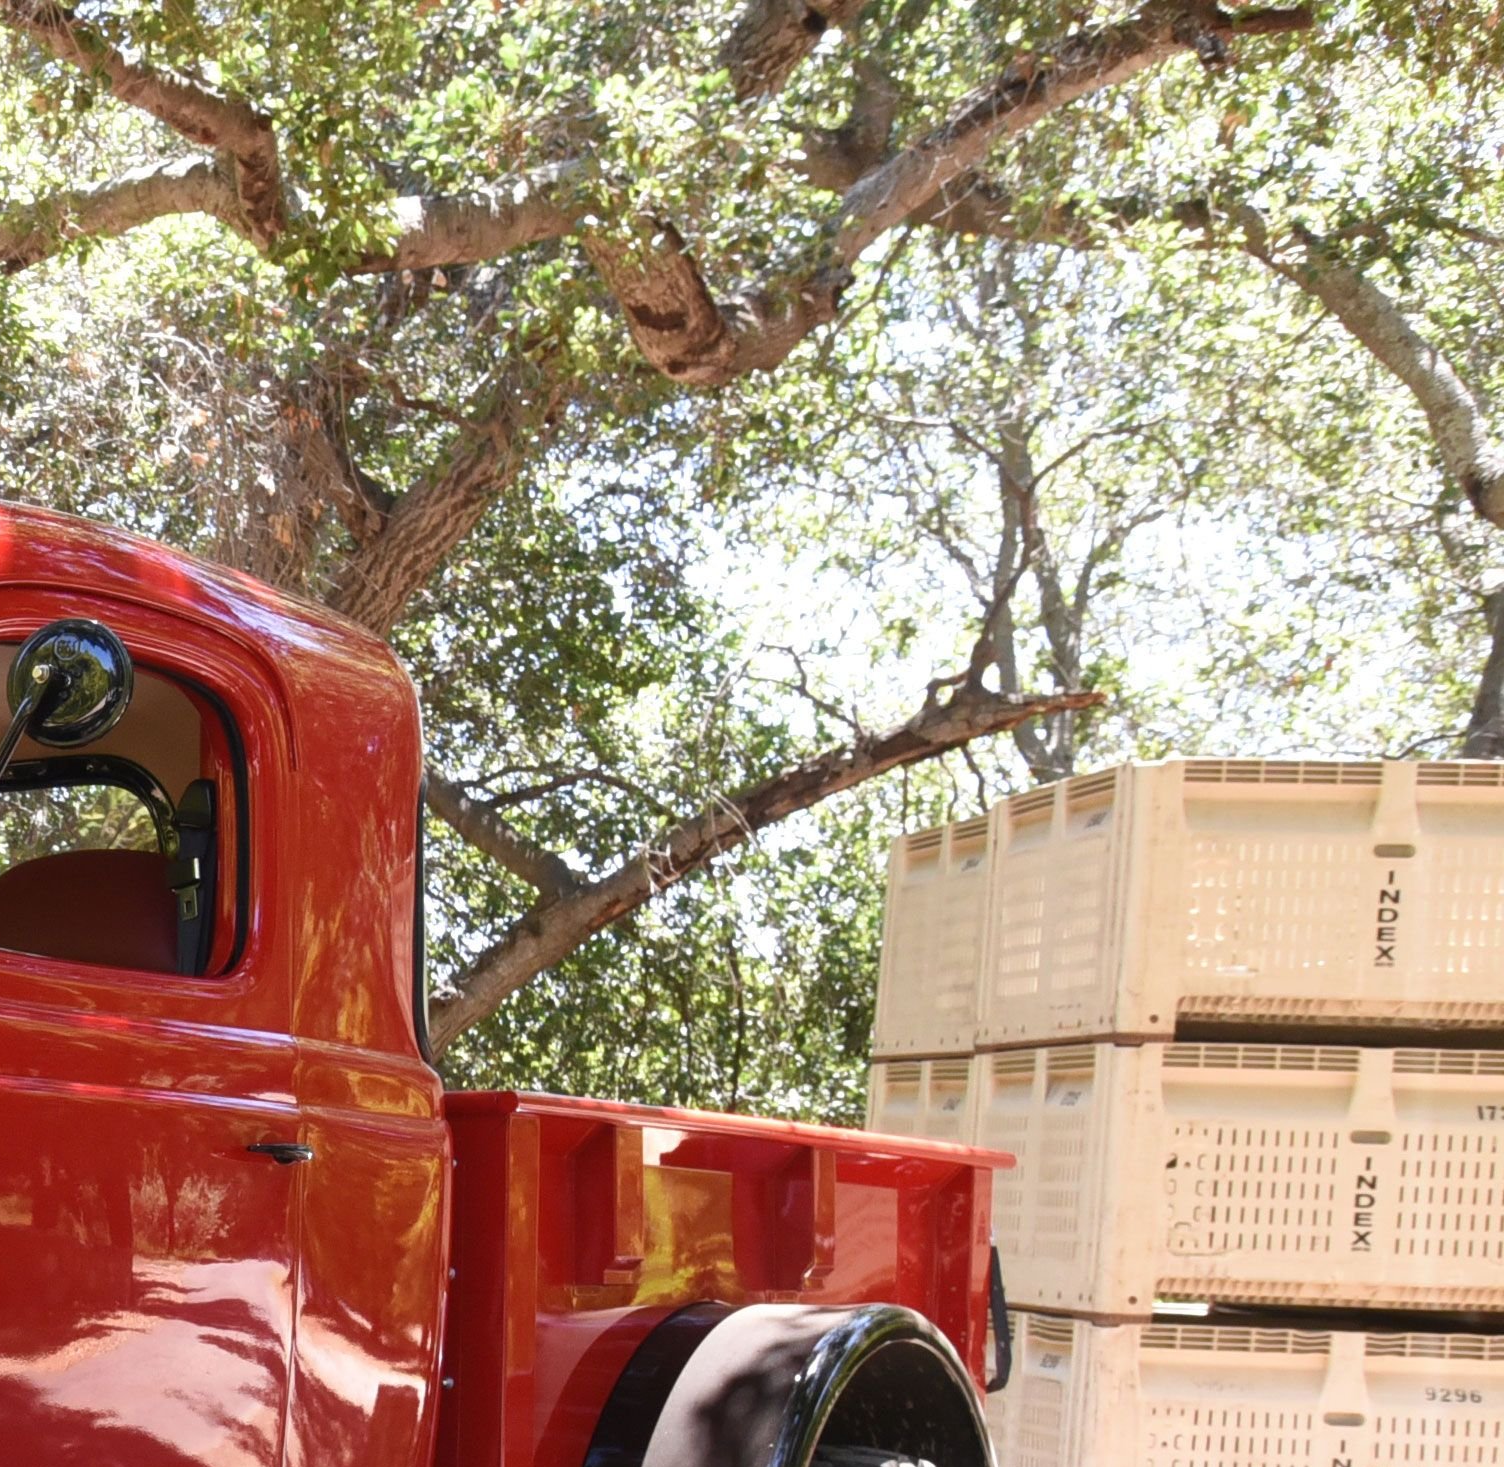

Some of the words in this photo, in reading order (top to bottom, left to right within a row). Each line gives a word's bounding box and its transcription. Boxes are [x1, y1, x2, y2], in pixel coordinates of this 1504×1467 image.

[1374, 870, 1400, 961] INDEX
[1477, 1105, 1504, 1121] 17
[1352, 1157, 1377, 1246] INDEX
